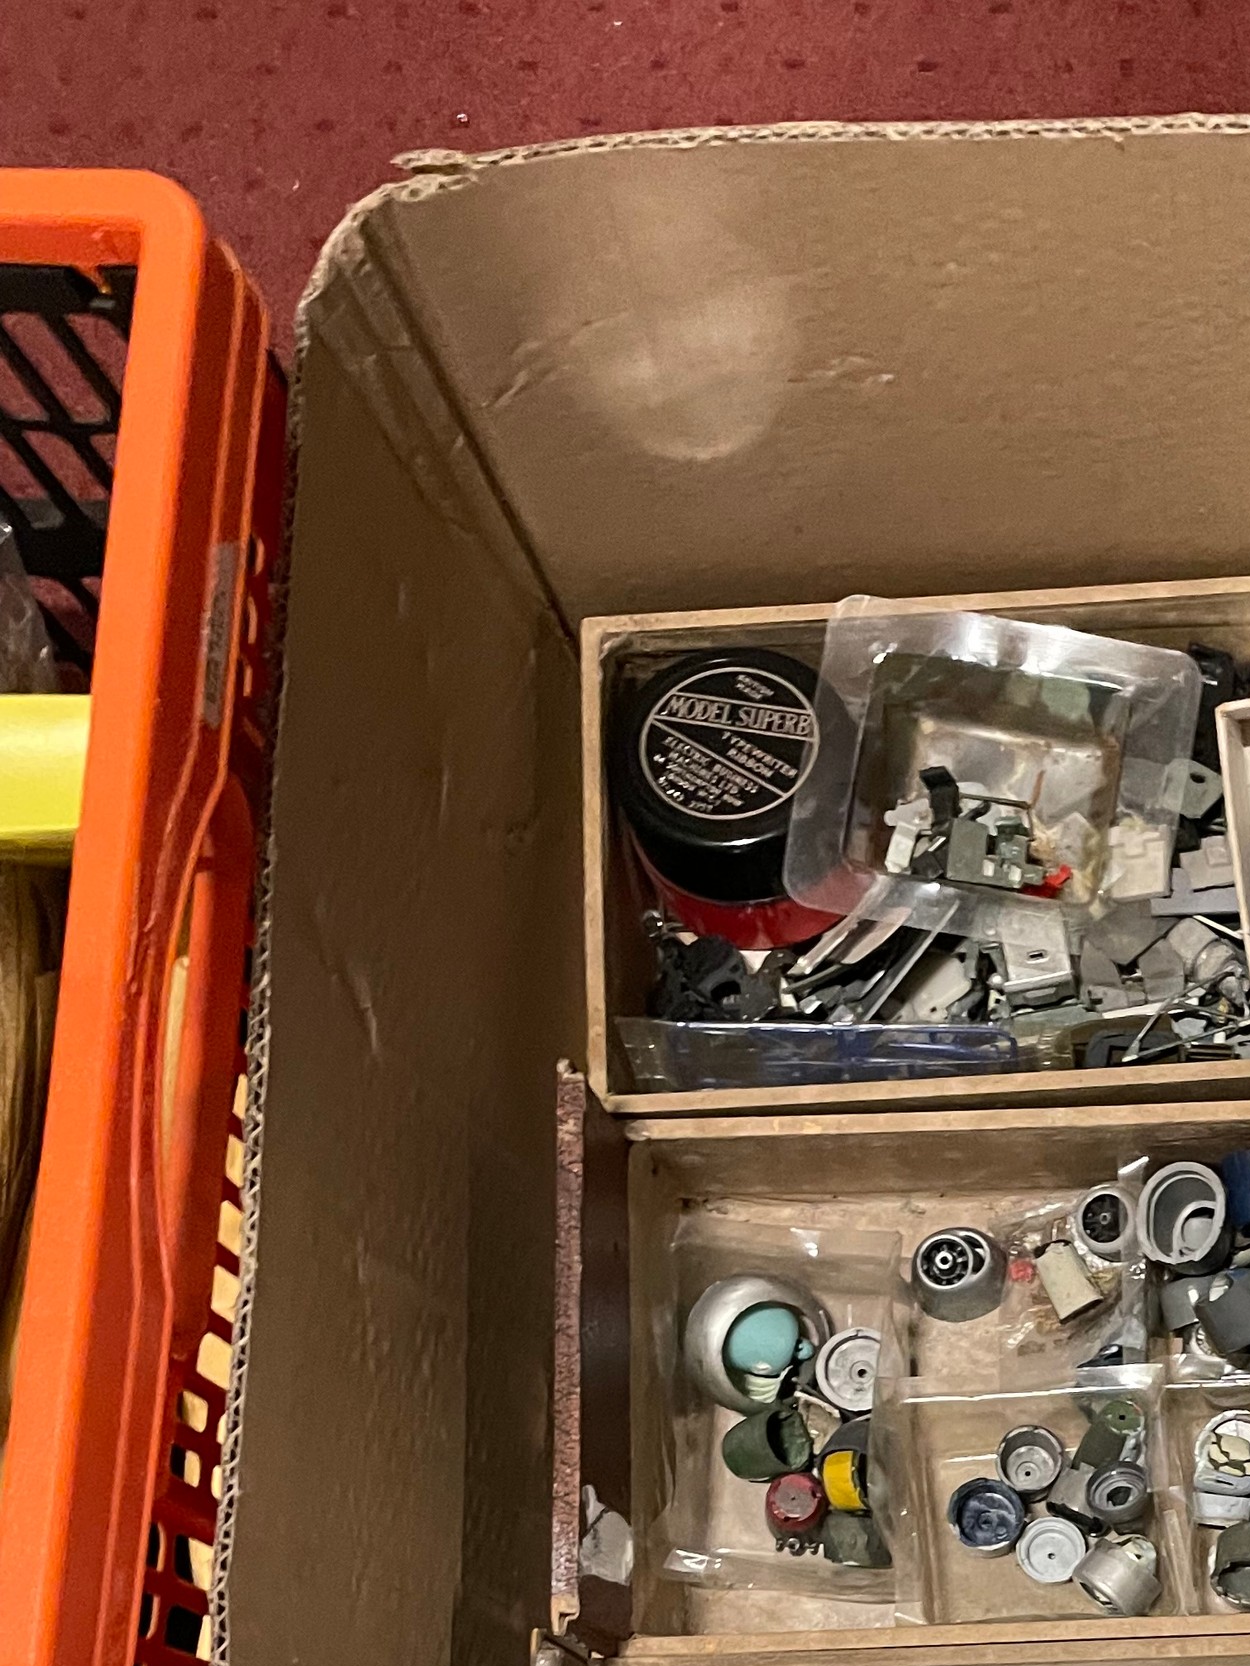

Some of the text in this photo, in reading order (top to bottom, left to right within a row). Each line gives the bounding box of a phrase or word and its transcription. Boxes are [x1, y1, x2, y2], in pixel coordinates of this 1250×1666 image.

[660, 696, 811, 735] MODEL SUPERB
[721, 731, 798, 778] TYPEWRITER
[726, 748, 775, 778] RIBBON
